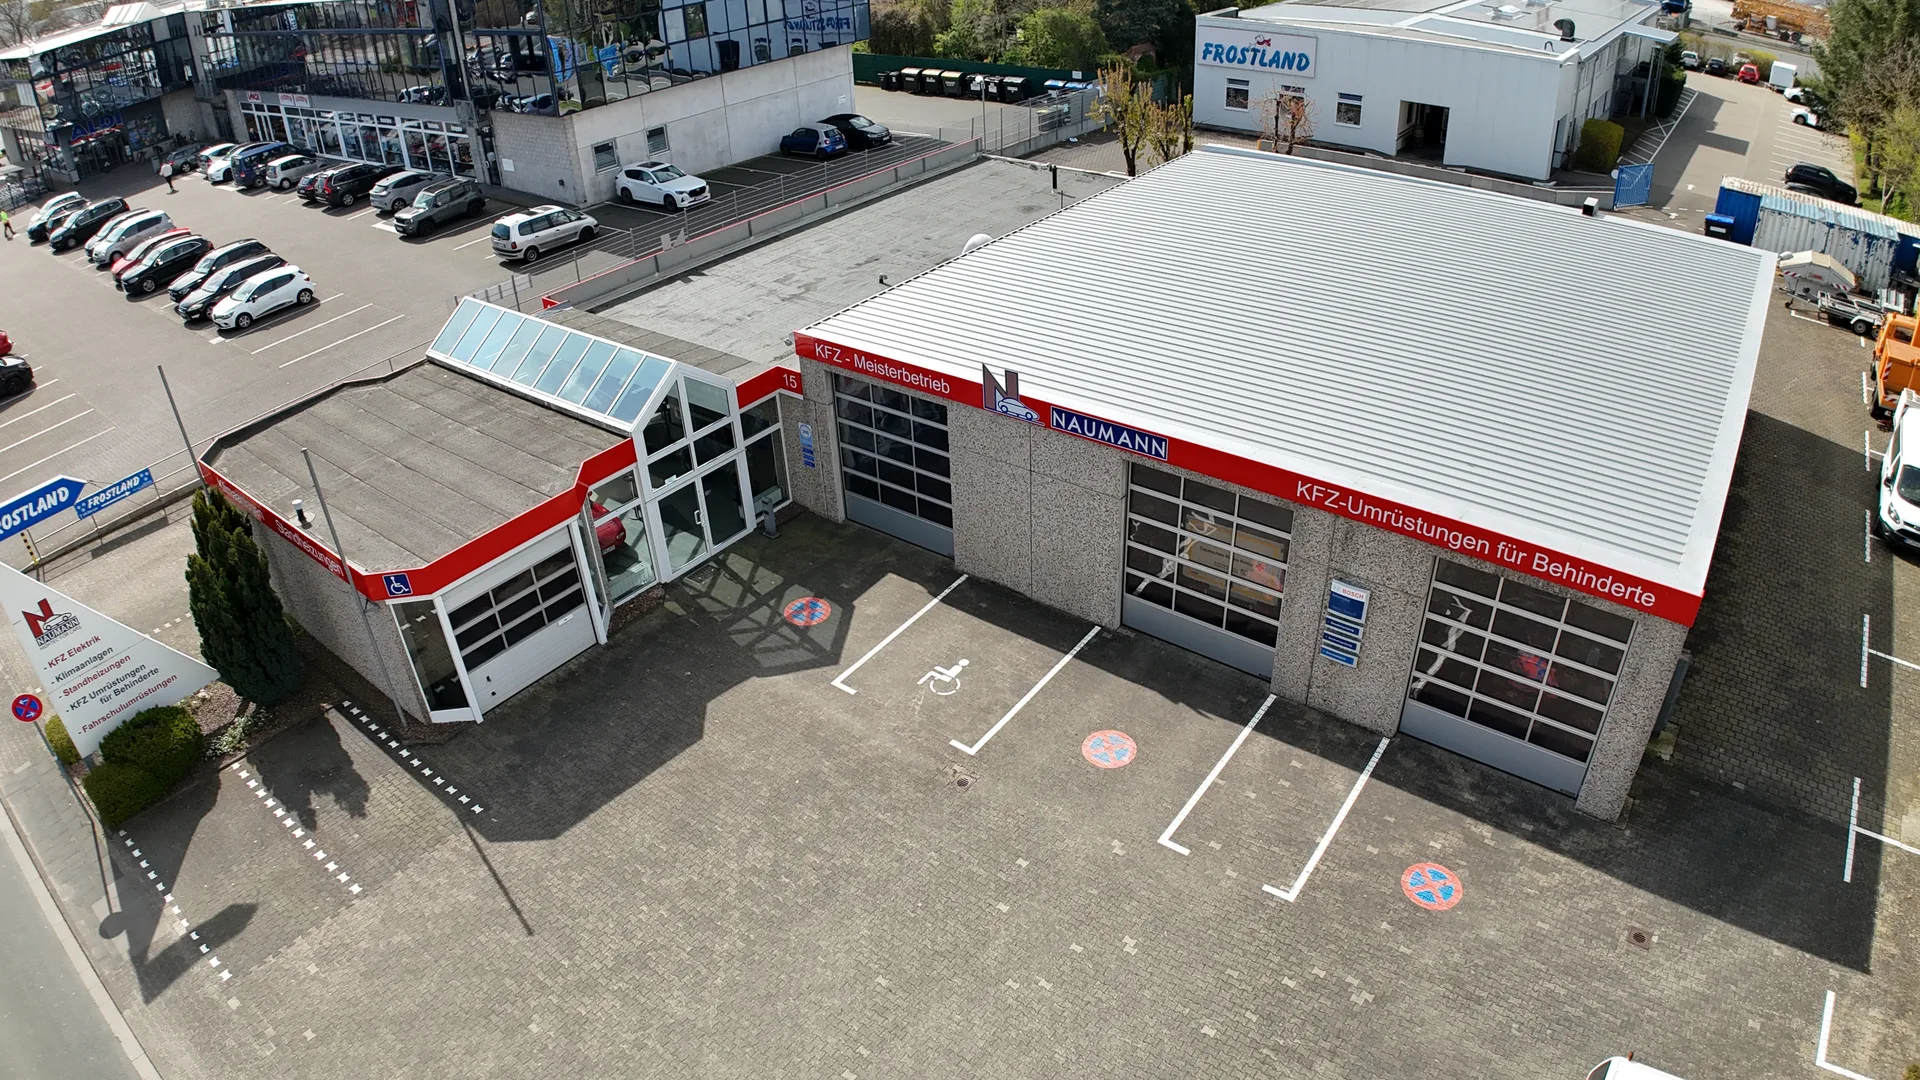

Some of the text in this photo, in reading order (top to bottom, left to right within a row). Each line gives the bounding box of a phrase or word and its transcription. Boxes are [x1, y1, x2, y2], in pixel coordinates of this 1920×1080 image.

[1202, 42, 1310, 72] FROSTLAND
[71, 112, 123, 140] ALDI
[782, 373, 797, 389] 15
[814, 342, 843, 363] KFZ
[854, 353, 950, 394] Meisterbetrieb
[1052, 410, 1166, 459] NAUMANN
[0, 486, 70, 536] OSTLAND
[87, 476, 140, 509] FROSTLAND
[275, 519, 345, 577] Standheizungen
[1296, 480, 1656, 608] KFZ-Umrüstungen für Behinderte
[1341, 586, 1365, 600] BOSCH
[37, 617, 80, 646] NAUMANN
[47, 634, 101, 669] KFZ Elektrik
[55, 646, 114, 683] Klimaanlagen
[63, 654, 131, 697] Standheizungen
[69, 663, 147, 711] KFZ Umrüstungen
[99, 666, 160, 705] für Behinderte
[82, 673, 178, 734] Fahrschulumrüstungen
